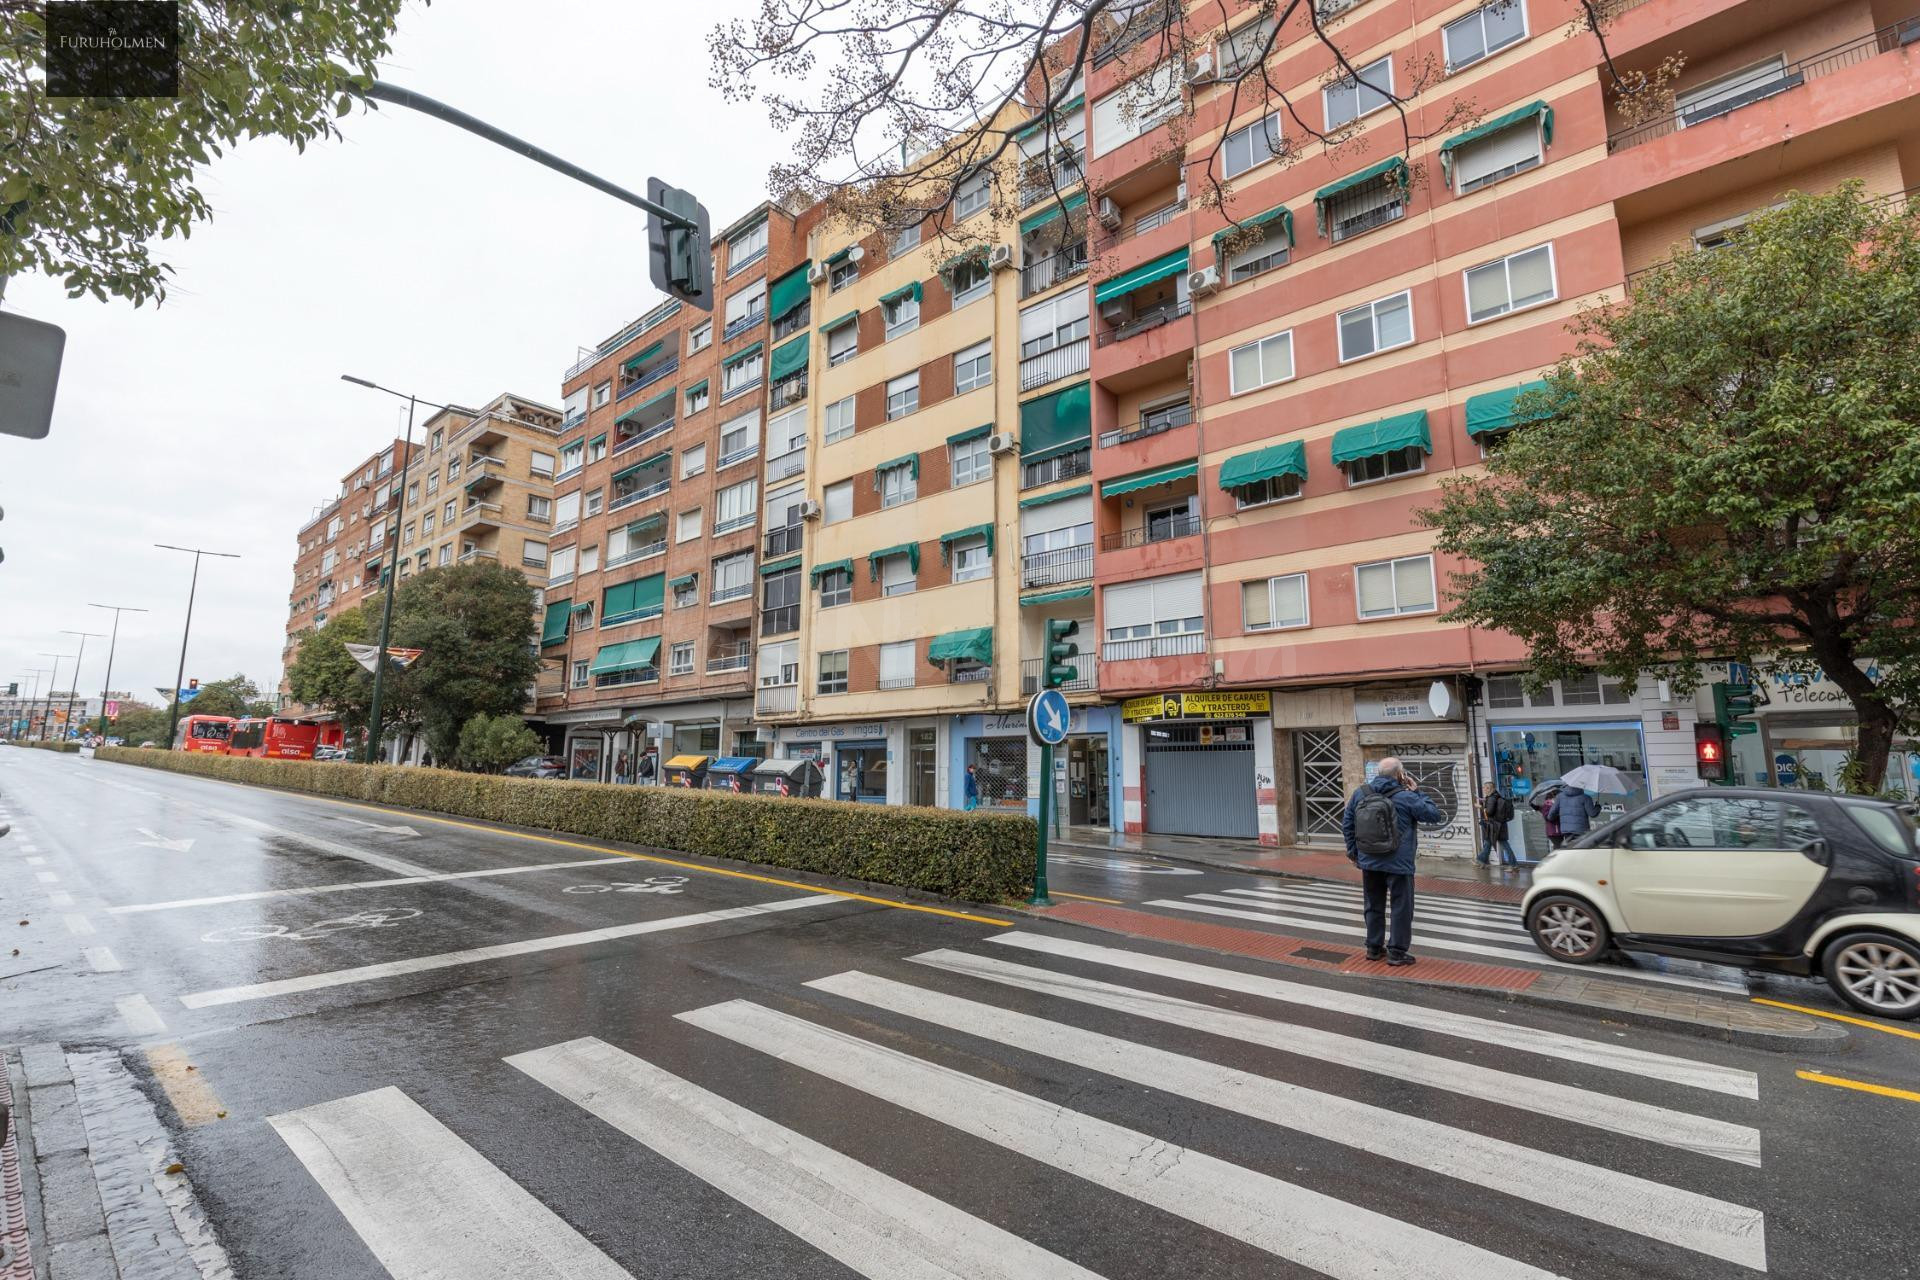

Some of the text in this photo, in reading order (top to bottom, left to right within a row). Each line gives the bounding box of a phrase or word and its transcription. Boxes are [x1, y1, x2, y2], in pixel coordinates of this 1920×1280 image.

[1185, 692, 1266, 704] ALQUILER DE GARAJES
[1208, 703, 1251, 711] TRASTEROS
[795, 726, 845, 738] Centro del Gas
[281, 747, 301, 756] alsa
